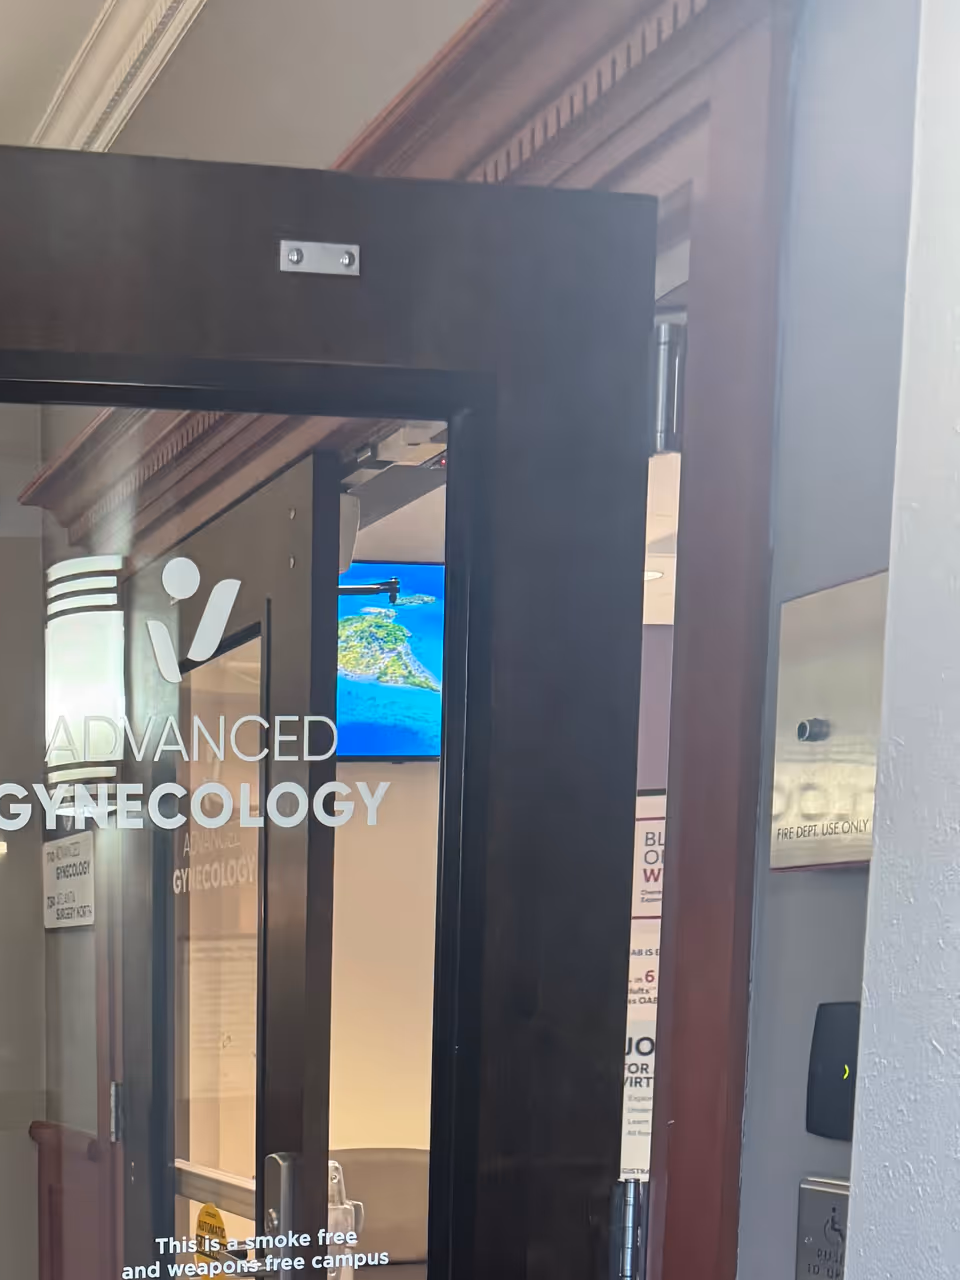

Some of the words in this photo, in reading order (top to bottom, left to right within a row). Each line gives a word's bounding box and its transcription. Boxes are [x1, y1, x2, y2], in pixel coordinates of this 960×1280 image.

[44, 714, 338, 762] ADVANCED
[777, 826, 794, 841] FIRE
[796, 824, 819, 839] DEPT.
[822, 822, 839, 836] USE
[842, 818, 869, 834] ONLY
[172, 855, 256, 894] GYNECOLOGY
[645, 970, 654, 983] 6
[155, 1236, 197, 1255] This
[204, 1236, 220, 1252] is
[227, 1238, 244, 1250] a
[246, 1231, 311, 1250] smoke
[318, 1229, 358, 1246] free
[122, 1260, 160, 1280] and
[168, 1259, 259, 1278] weapons
[265, 1254, 306, 1272] free
[312, 1250, 390, 1270] campus
